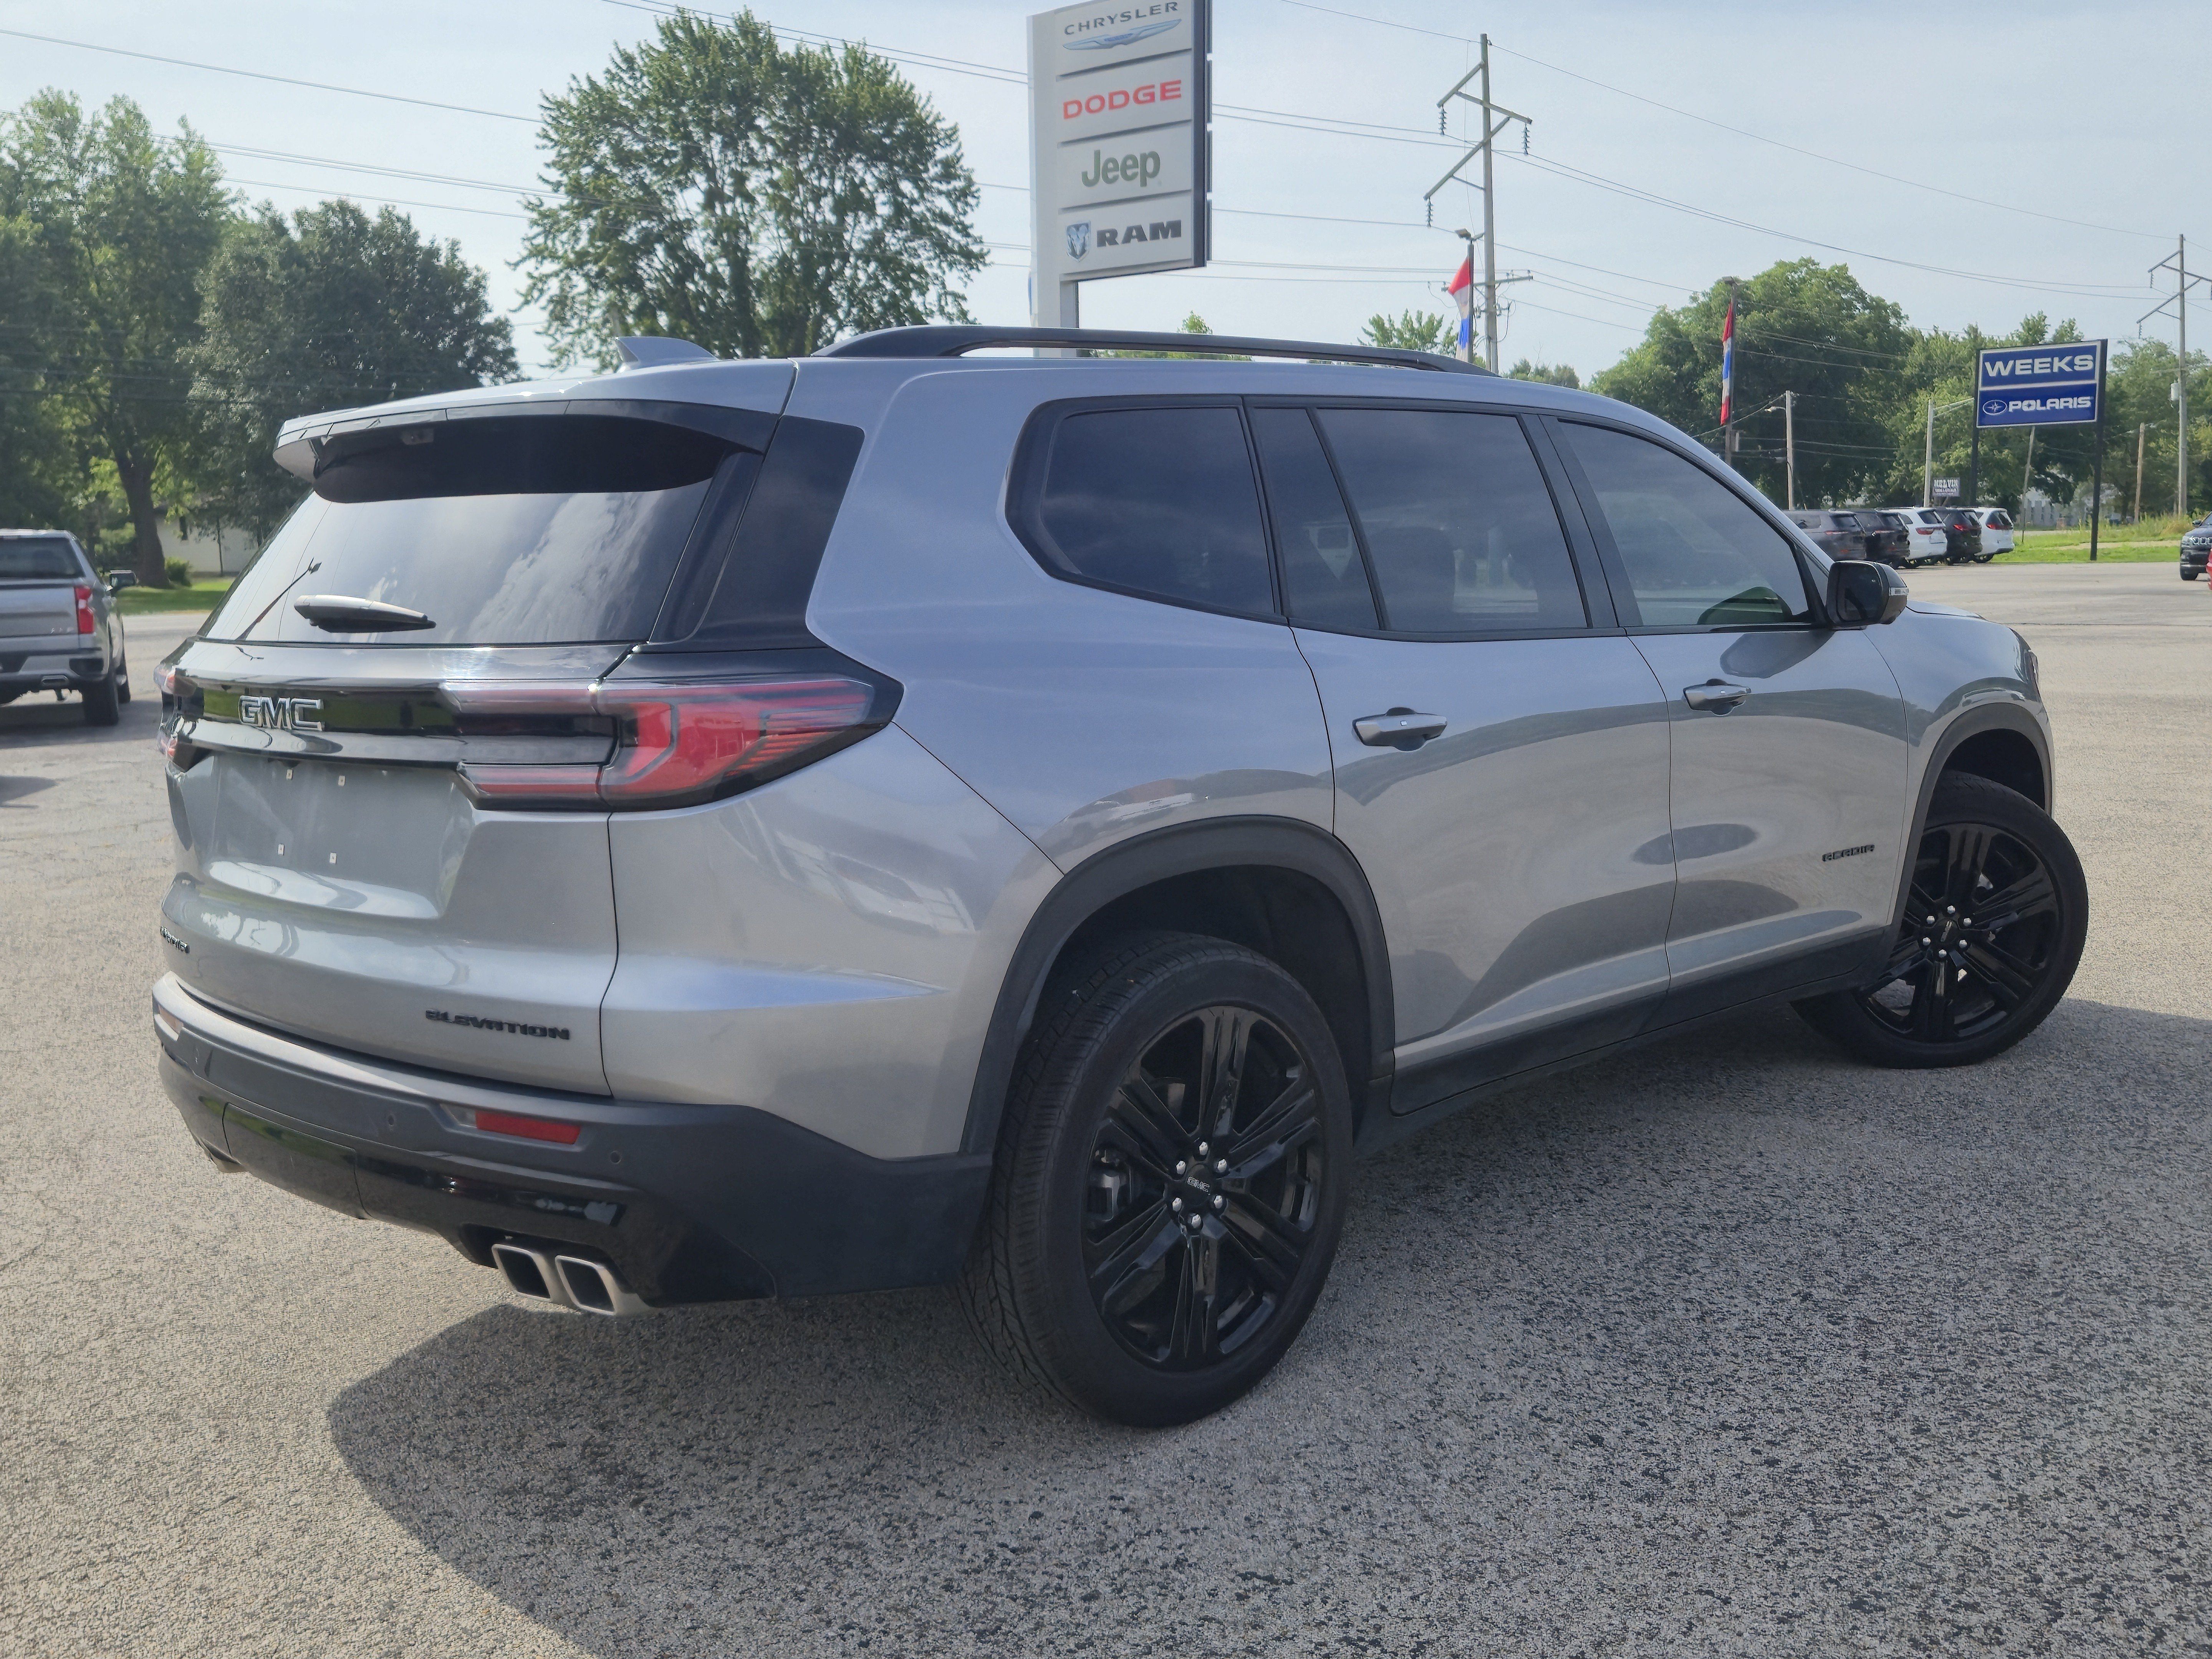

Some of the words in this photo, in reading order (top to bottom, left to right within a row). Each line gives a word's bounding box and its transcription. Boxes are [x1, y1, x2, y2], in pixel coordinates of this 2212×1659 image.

[1064, 2, 1179, 35] CHRYSLER
[1063, 79, 1182, 119] DODGE
[1081, 149, 1161, 187] Jeep
[1096, 219, 1182, 247] RAM
[1984, 354, 2094, 377] WEEKS
[2008, 396, 2091, 412] POLARIS
[238, 695, 325, 732] GMC
[425, 1008, 570, 1040] ELEVATION
[1187, 1176, 1210, 1192] GMC
